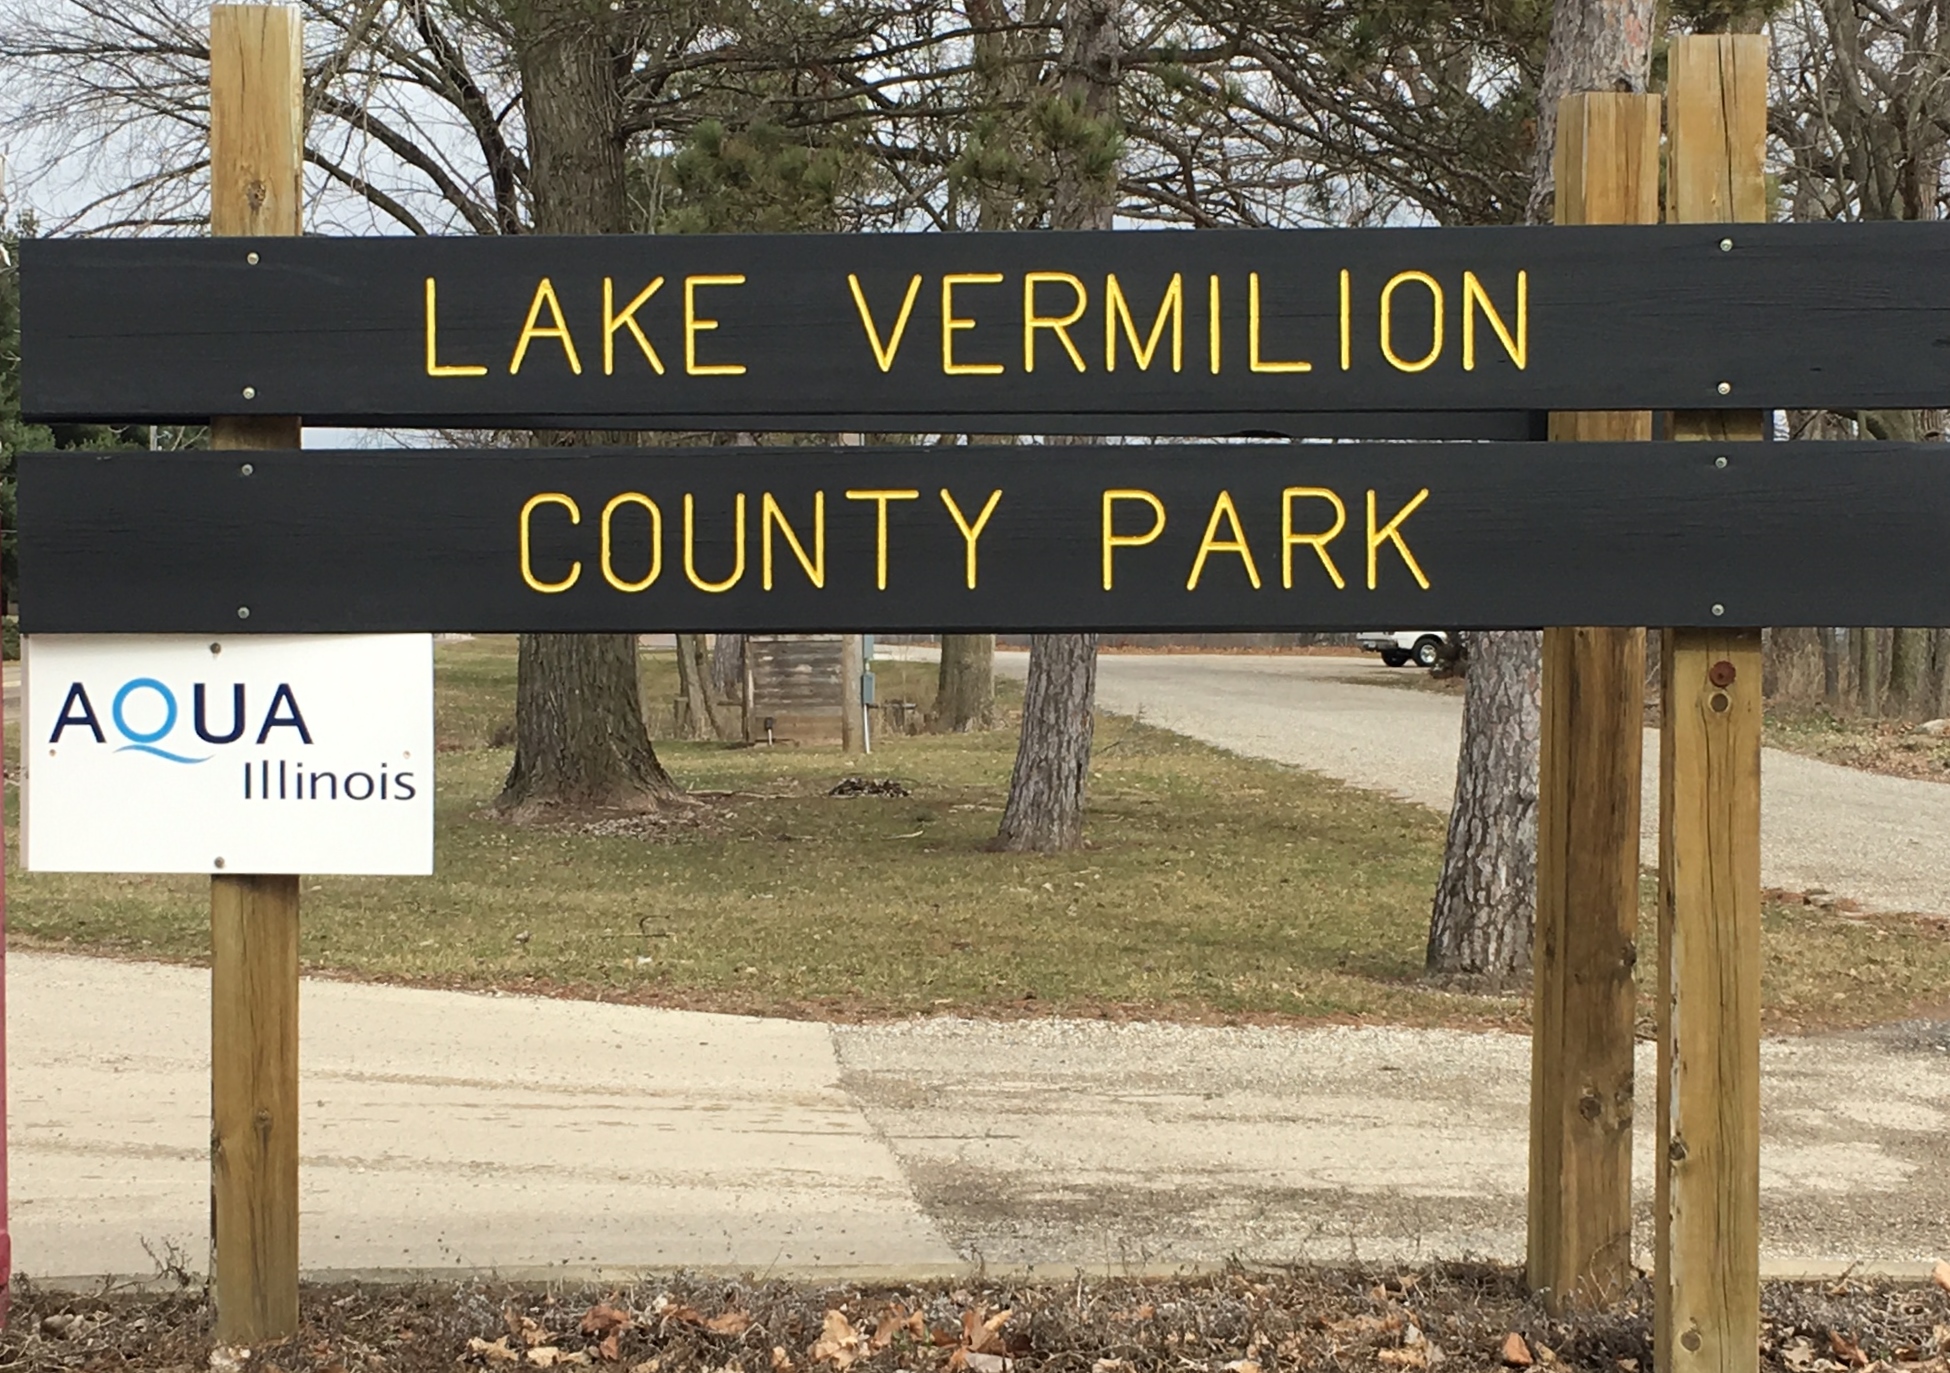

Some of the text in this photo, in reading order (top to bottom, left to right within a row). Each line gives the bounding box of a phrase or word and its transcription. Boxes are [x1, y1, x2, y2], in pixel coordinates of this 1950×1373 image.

[424, 267, 1529, 378] LAKE VERMILION
[518, 486, 1432, 595] COUNTY PARK
[49, 677, 314, 764] AQUA
[243, 759, 417, 801] Illinois
